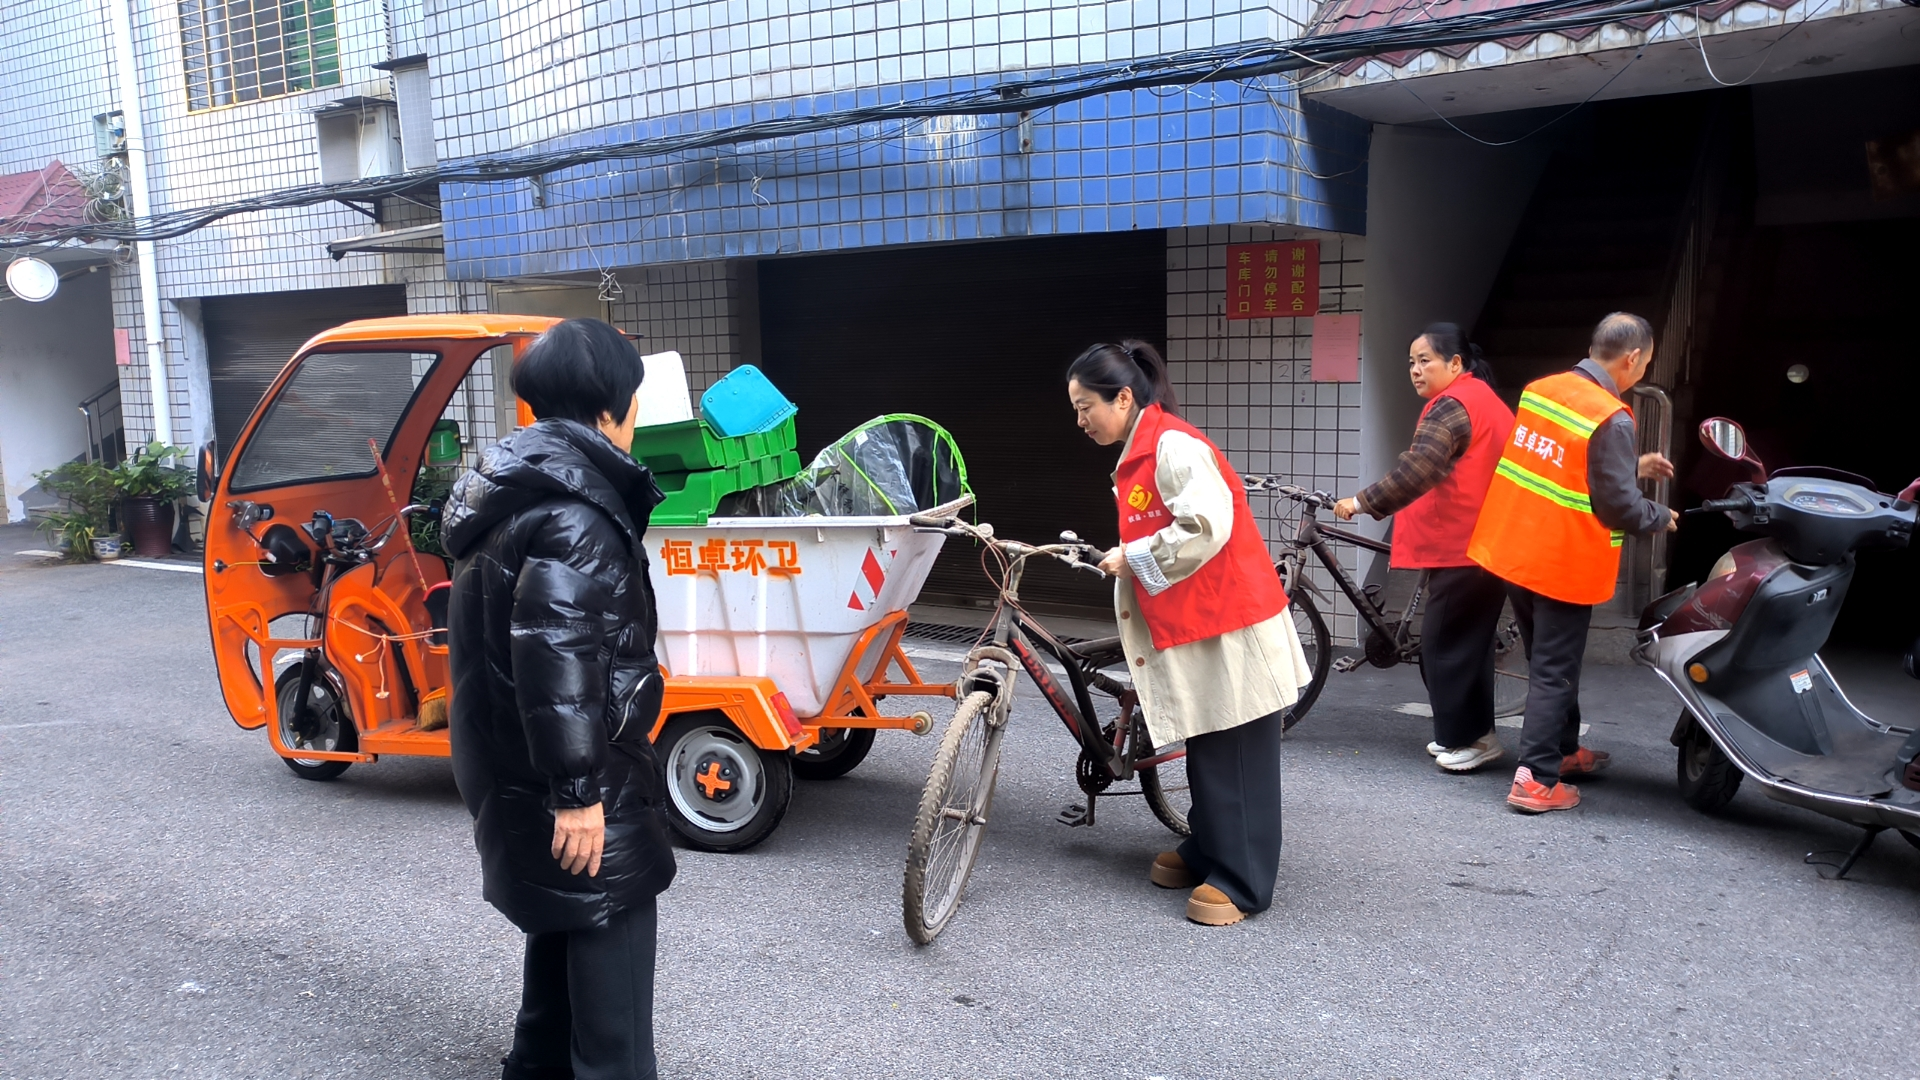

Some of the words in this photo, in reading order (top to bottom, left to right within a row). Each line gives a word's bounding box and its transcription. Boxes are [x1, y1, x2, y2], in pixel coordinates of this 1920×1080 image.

[1238, 252, 1251, 313] 车库门口
[1264, 249, 1278, 312] 请勿停车
[1291, 247, 1305, 311] 谢谢配合
[1513, 424, 1565, 468] 恒卓环卫
[660, 538, 802, 577] 恒卓环卫
